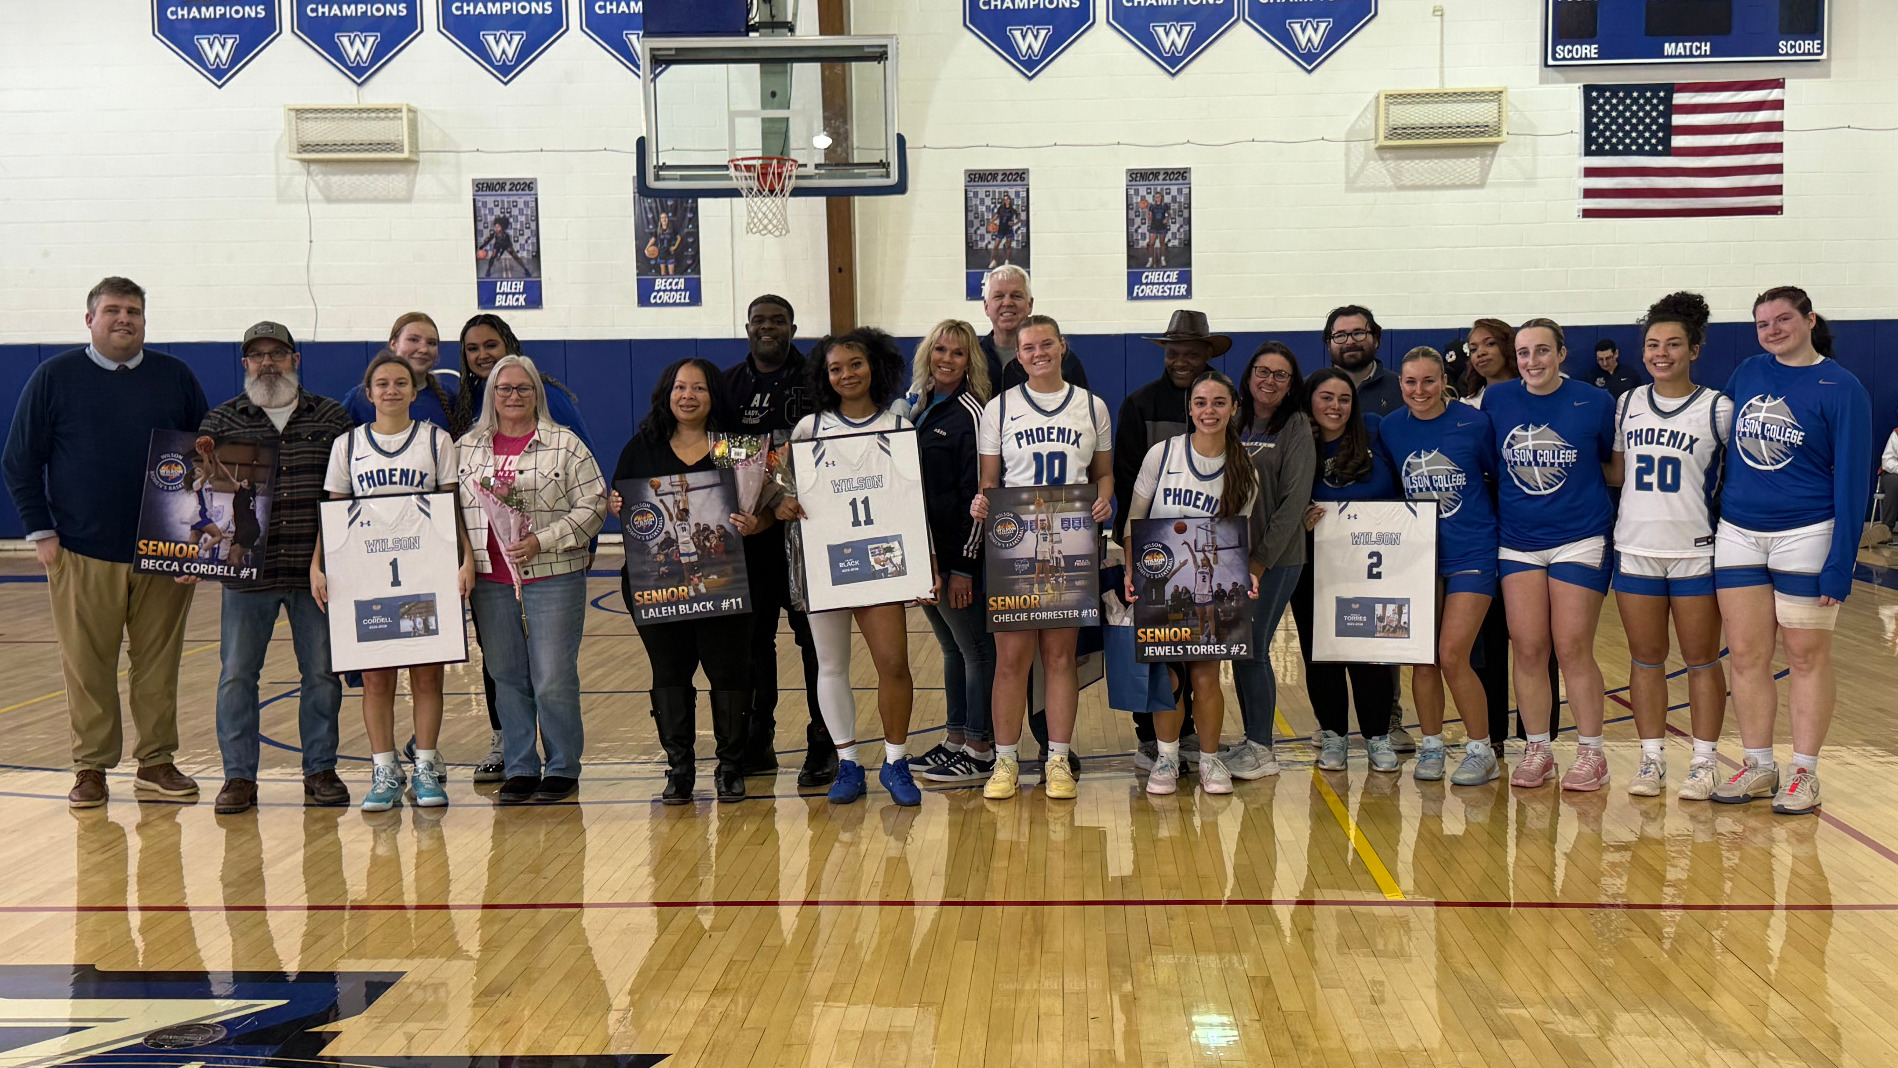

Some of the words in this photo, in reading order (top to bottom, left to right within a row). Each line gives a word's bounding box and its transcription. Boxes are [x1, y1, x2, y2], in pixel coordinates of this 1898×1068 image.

[166, 5, 266, 20] CHAMPIONS
[306, 4, 408, 17] CHAMPIONS
[451, 2, 553, 15] CHAMPIONS
[1007, 25, 1052, 60] W
[1150, 22, 1196, 57] W
[1286, 18, 1332, 53] W
[194, 34, 239, 69] W
[335, 32, 380, 66] W
[480, 30, 526, 65] W
[1555, 44, 1599, 59] SCORE
[1664, 42, 1710, 56] MATCH
[1778, 40, 1821, 54] SCORE
[967, 172, 999, 183] SENIOR
[1000, 172, 1026, 183] 2026
[1128, 172, 1160, 182] SENIOR
[1161, 171, 1188, 182] 2026
[475, 182, 507, 193] SENIOR
[508, 181, 534, 192] 2026
[654, 278, 685, 291] BECCA
[1141, 271, 1179, 284] CHELCIE
[496, 281, 524, 293] LALEH
[1133, 284, 1188, 297] FORRESTER
[495, 293, 527, 306] BLACK
[650, 291, 690, 304] CORDELL
[1014, 426, 1083, 449] PHOENIX
[1626, 427, 1700, 455] PHOENIX
[1764, 423, 1806, 446] COLLEGE
[1536, 449, 1578, 463] COLLEGE
[1033, 451, 1067, 485] 10
[1635, 454, 1682, 493] 20
[357, 468, 429, 492] PHOENIX
[831, 474, 884, 493] WILSON
[1431, 473, 1467, 488] COLLEGE
[1163, 487, 1220, 514] PHOENI
[849, 495, 874, 528] 11
[365, 536, 420, 553] WILSON
[1351, 532, 1401, 546] WILSON
[138, 539, 199, 559] SENIOR
[140, 559, 180, 572] BECCA
[183, 562, 236, 577] CORDELL
[239, 567, 257, 580] #1
[389, 557, 402, 587] 1
[1367, 551, 1383, 580] 2
[634, 586, 691, 606] SENIOR
[988, 594, 1041, 611] SENIOR
[641, 605, 676, 619] LALEH
[679, 601, 714, 615] BLACK
[720, 597, 743, 611] #11
[993, 612, 1028, 623] CHELCIE
[1030, 609, 1079, 621] FORRESTER
[1081, 608, 1098, 618] #10
[1137, 627, 1191, 643] SENIOR
[1144, 645, 1183, 656] JEWELS
[1186, 644, 1227, 655] TORRES
[1230, 643, 1247, 656] #2
